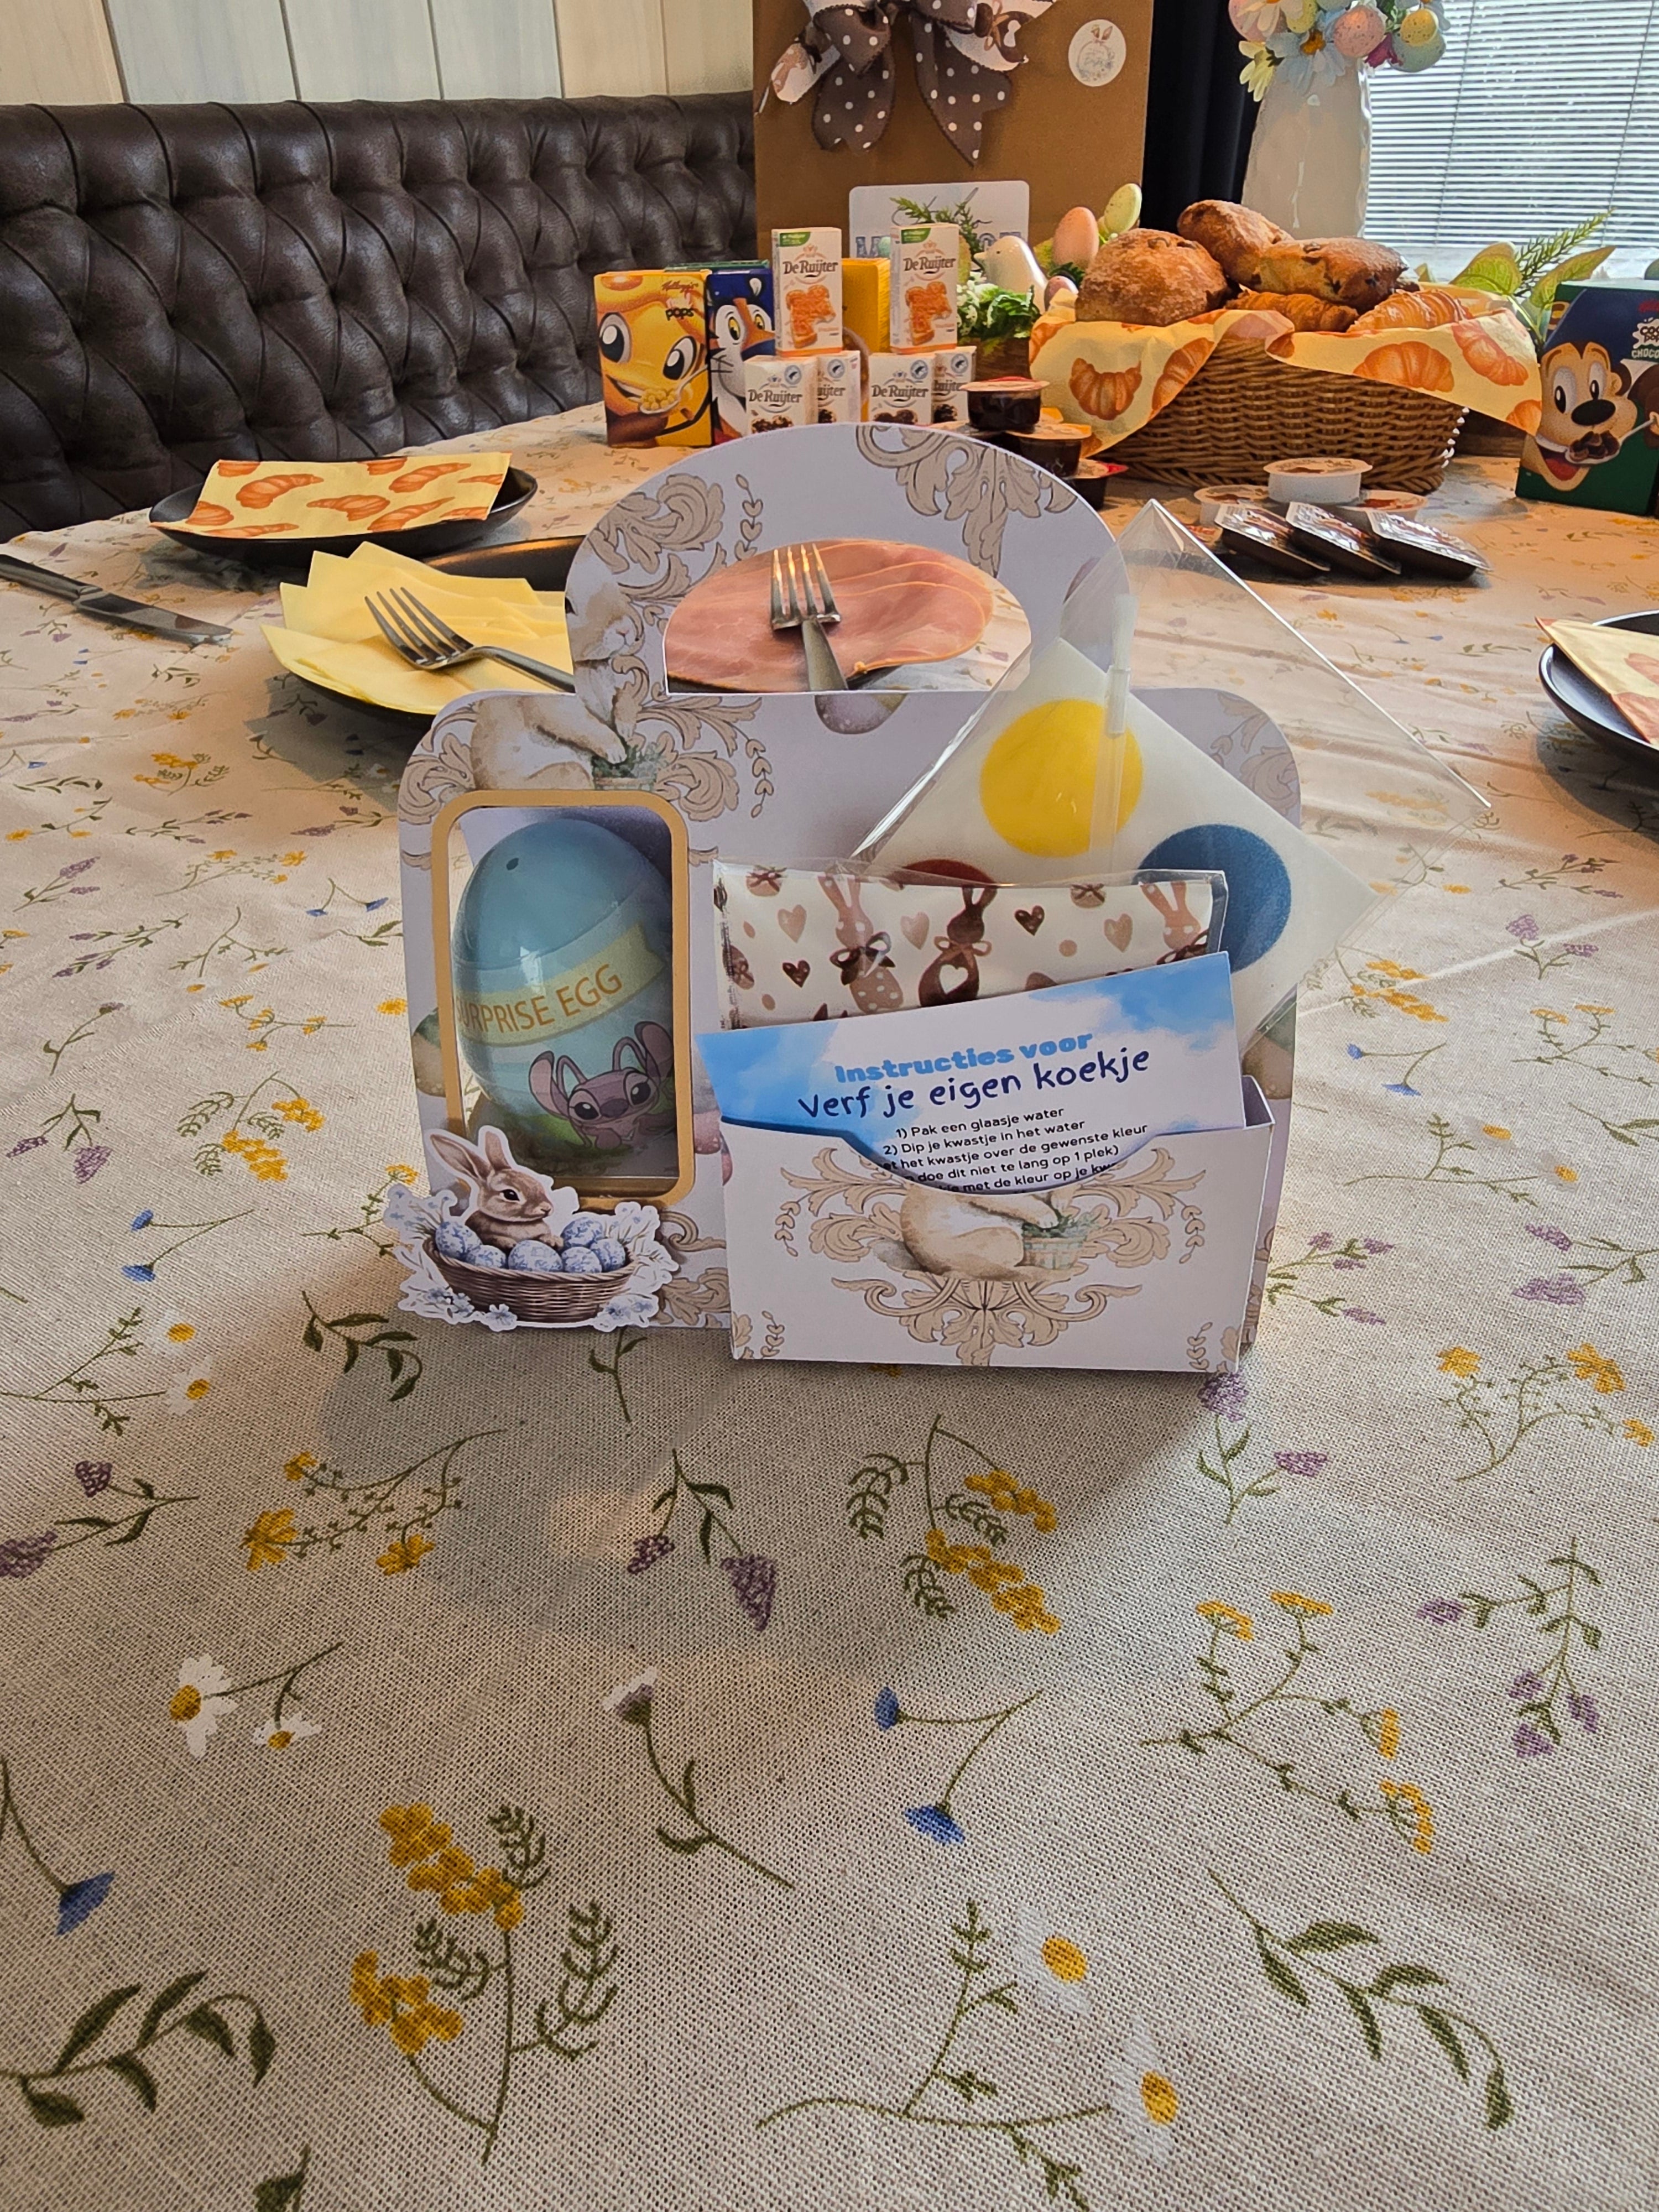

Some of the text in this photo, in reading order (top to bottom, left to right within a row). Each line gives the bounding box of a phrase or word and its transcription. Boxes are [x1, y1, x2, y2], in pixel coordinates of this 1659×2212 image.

[782, 259, 838, 278] De Ruijter
[903, 257, 919, 271] De
[748, 389, 803, 407] De Ruijter
[872, 384, 928, 401] De Ruijter
[556, 964, 623, 1017] EGG
[834, 1033, 1093, 1083] Instructies voor
[883, 1085, 914, 1118] je
[930, 1075, 1021, 1109] eigen
[1033, 1047, 1149, 1089] koekje
[883, 1120, 1085, 1156] 2) Dip je kwastje in het water
[896, 1108, 1064, 1139] 1) Pak een glaasje water
[900, 1159, 924, 1169] het
[927, 1152, 979, 1165] kwastje
[983, 1147, 1015, 1160] over
[1019, 1144, 1036, 1154] de
[1041, 1133, 1109, 1154] gewenste
[1112, 1124, 1148, 1139] kleur
[917, 1172, 943, 1182] doe
[948, 1168, 967, 1179] dit
[970, 1165, 997, 1176] niet
[1001, 1163, 1015, 1172] te
[1018, 1159, 1048, 1170] lang
[1052, 1155, 1071, 1166] op
[1074, 1151, 1079, 1161] 1
[1084, 1145, 1119, 1163] plek)
[963, 1180, 990, 1192] met
[994, 1177, 1011, 1188] de
[1015, 1173, 1049, 1186] kleur
[1053, 1171, 1072, 1181] op
[1075, 1167, 1087, 1180] je
